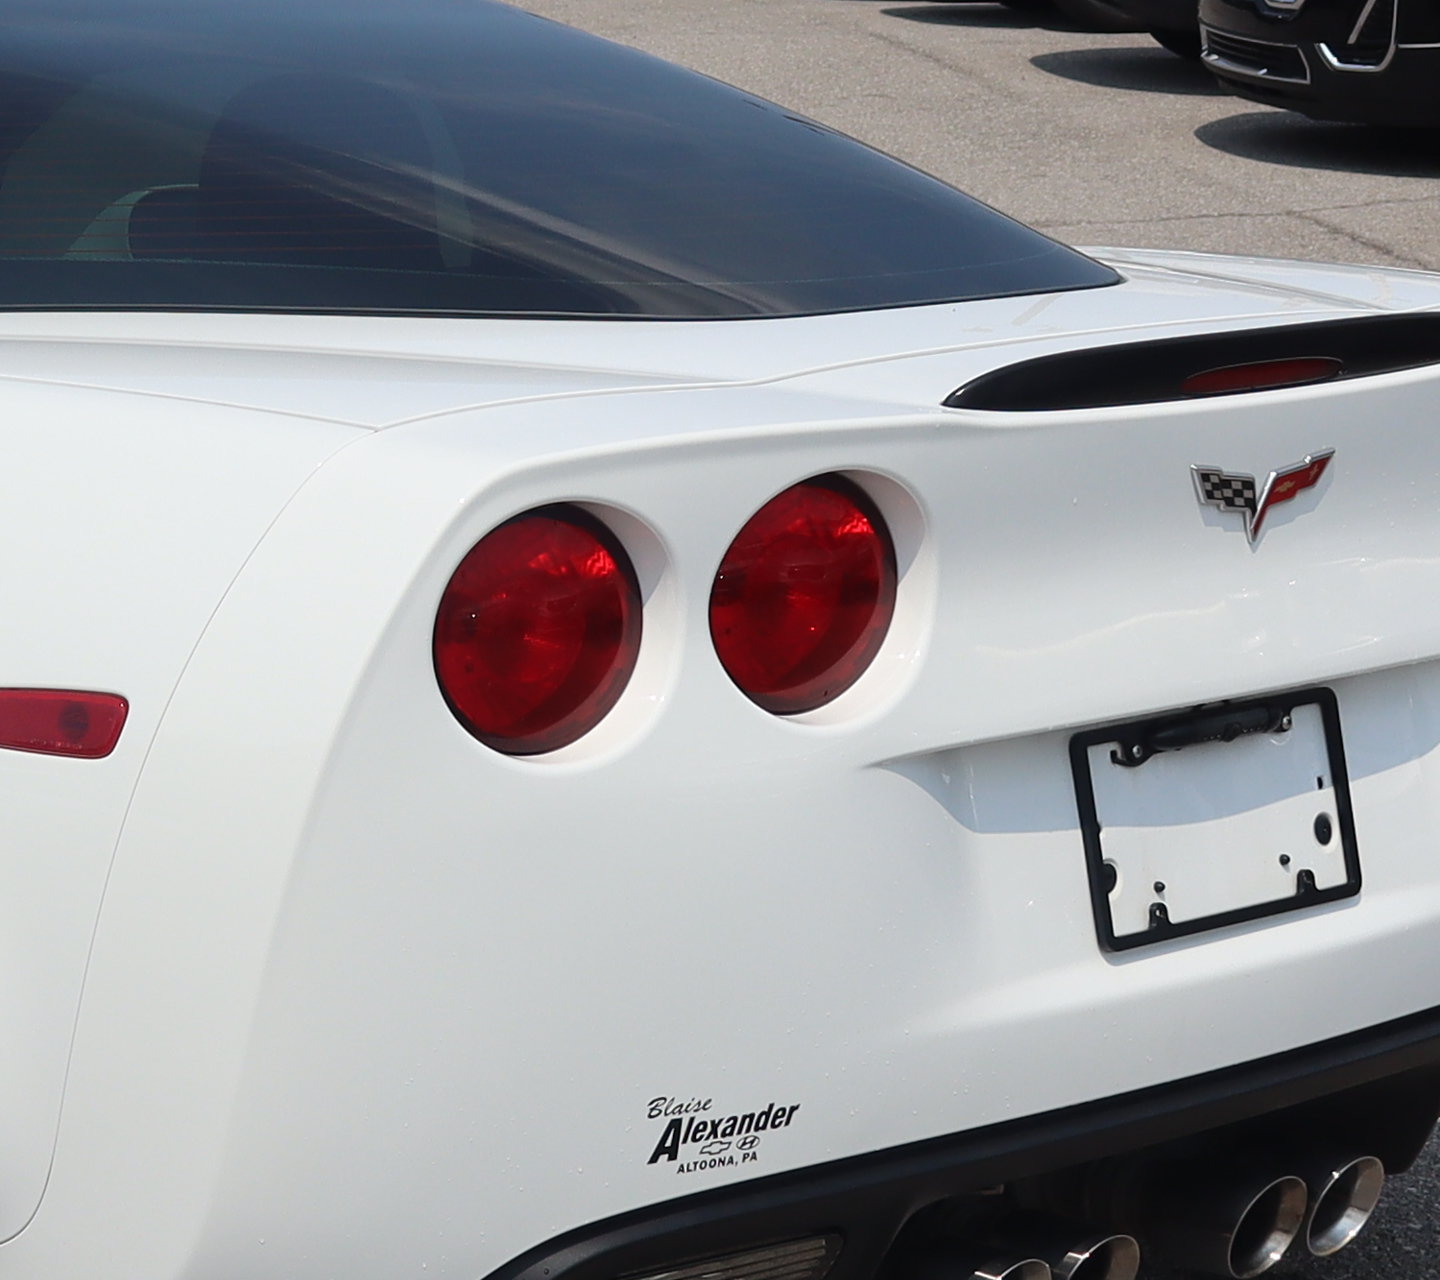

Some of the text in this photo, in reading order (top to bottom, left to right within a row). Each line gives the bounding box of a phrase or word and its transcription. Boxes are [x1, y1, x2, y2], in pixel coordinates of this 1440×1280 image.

[647, 1096, 713, 1119] Blaise
[646, 1102, 802, 1166] Alexander
[676, 1151, 759, 1175] ALTOONA, PA
